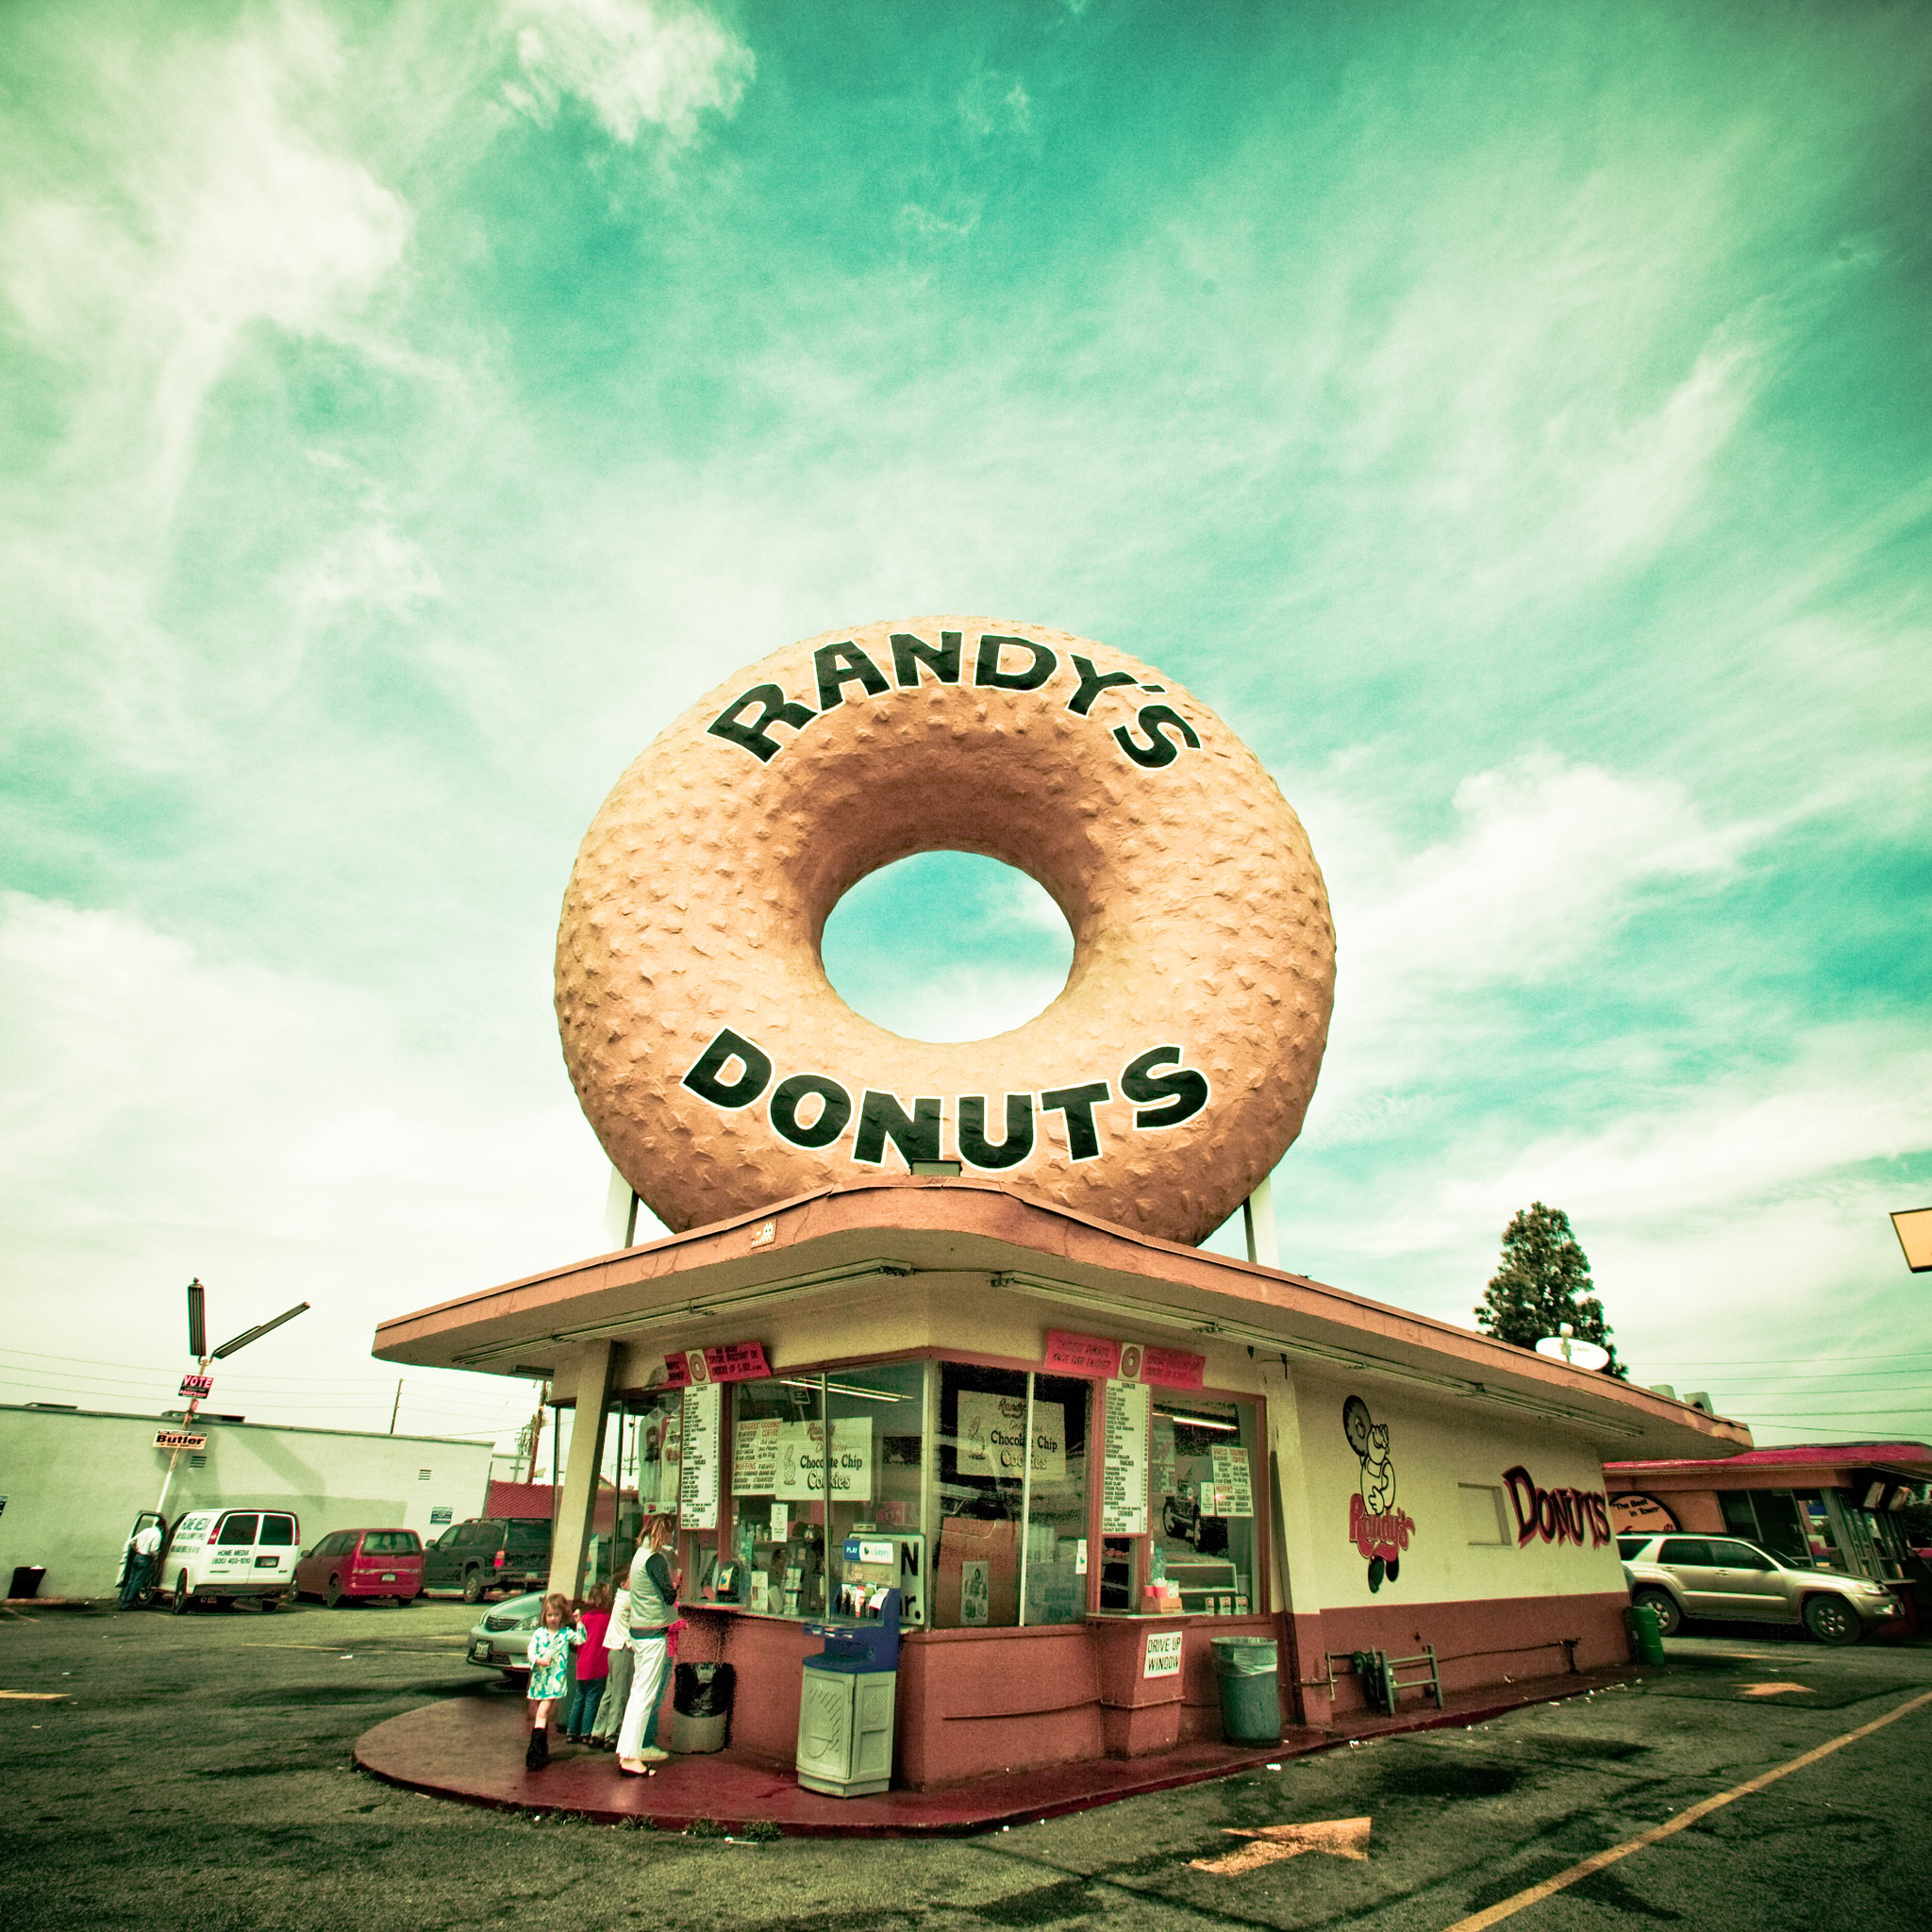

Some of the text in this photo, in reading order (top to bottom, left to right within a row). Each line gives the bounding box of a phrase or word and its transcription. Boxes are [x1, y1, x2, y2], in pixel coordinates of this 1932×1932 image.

[707, 629, 1203, 772] RANDY'S
[678, 1024, 1212, 1170] DONUTS
[183, 1375, 212, 1388] VOTE
[740, 1422, 758, 1430] BAGELS
[156, 1434, 205, 1444] Butler
[1038, 1435, 1058, 1453] Chip
[841, 1454, 862, 1471] Chip
[1501, 1464, 1611, 1550] DONUTS
[1630, 1499, 1648, 1507] Best
[1349, 1493, 1415, 1562] Randy's
[1148, 1637, 1181, 1653] DRIVE UP
[1148, 1656, 1180, 1671] WINDOW
